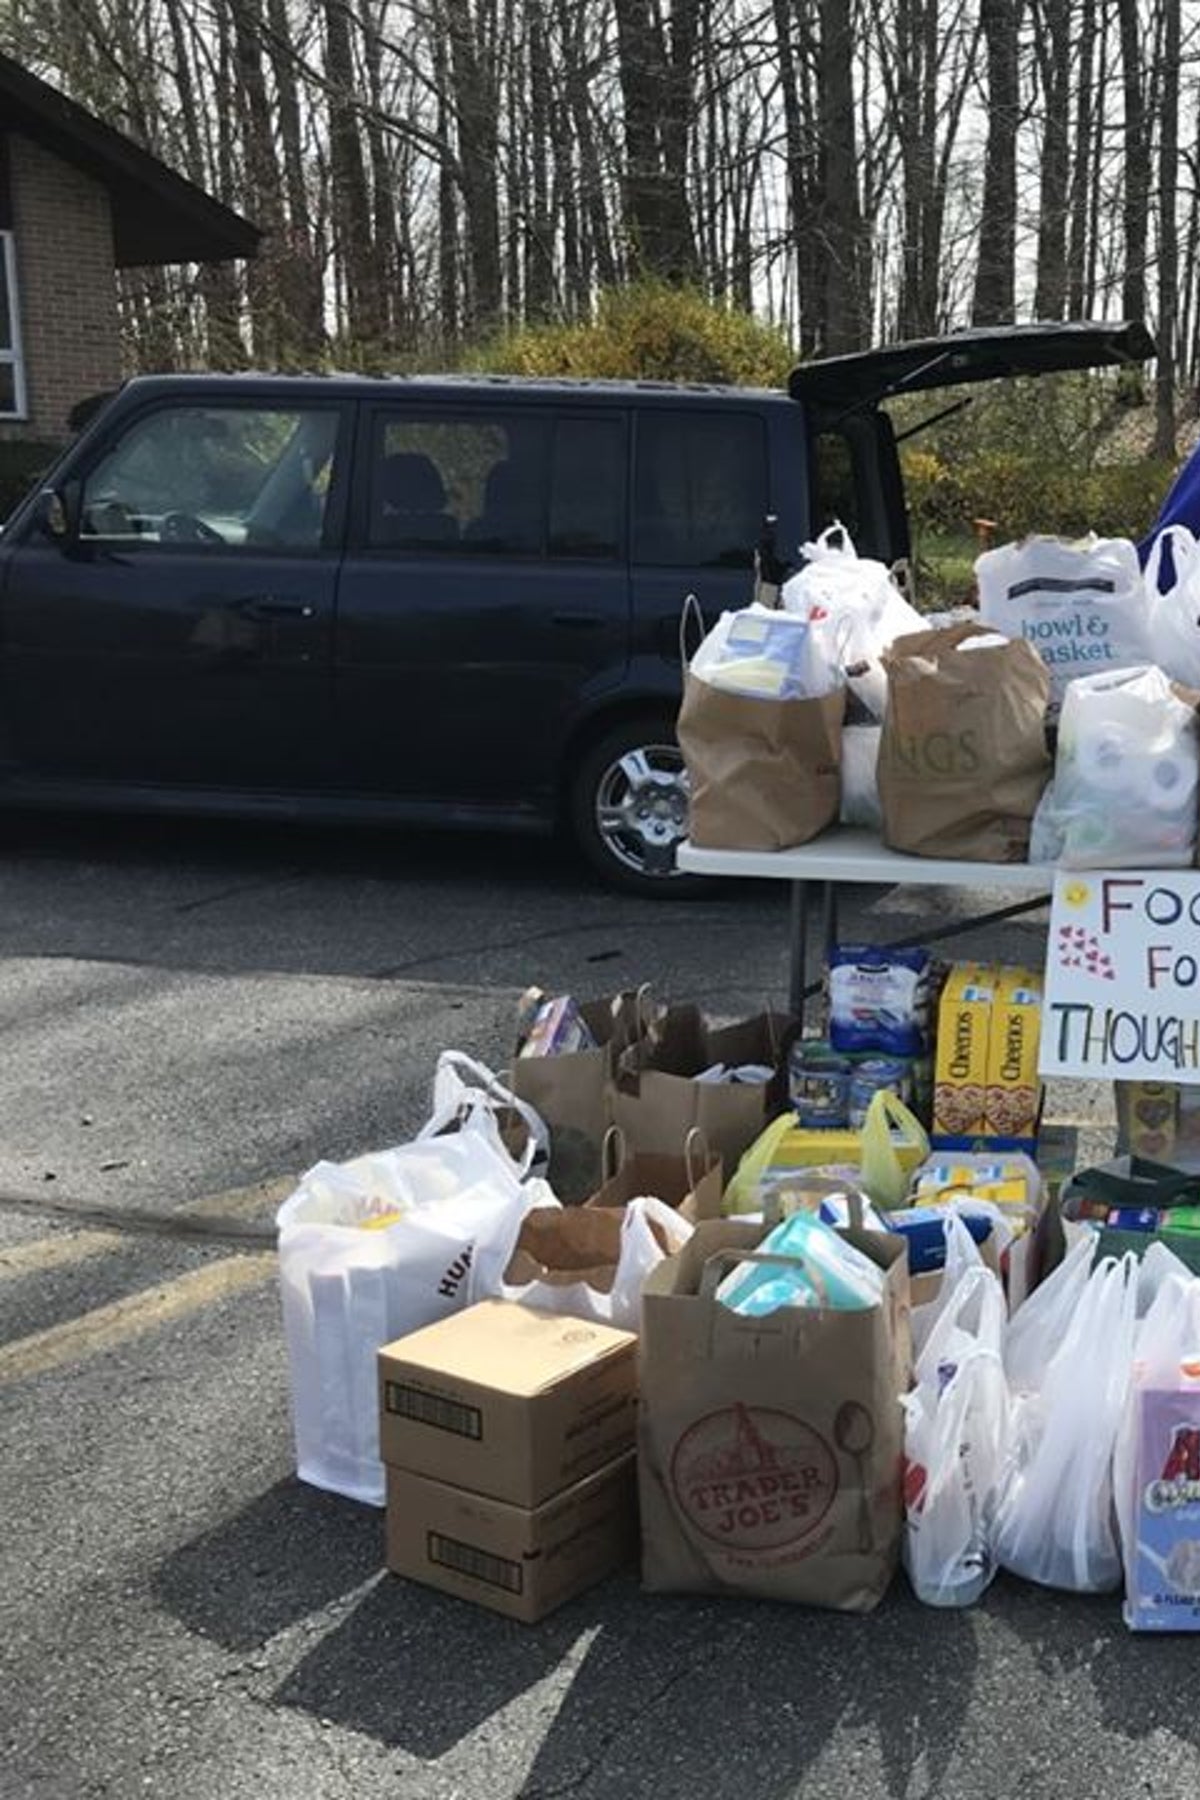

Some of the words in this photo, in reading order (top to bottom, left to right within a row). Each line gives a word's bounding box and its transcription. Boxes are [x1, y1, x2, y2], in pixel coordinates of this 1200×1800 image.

[1021, 614, 1082, 641] bowl
[1087, 615, 1109, 637] &
[1041, 639, 1113, 663] asket
[948, 1011, 973, 1078] Cheerios
[1001, 1014, 1024, 1081] Cheerios
[690, 1466, 827, 1511] TRADER
[717, 1493, 809, 1534] JOE'S
